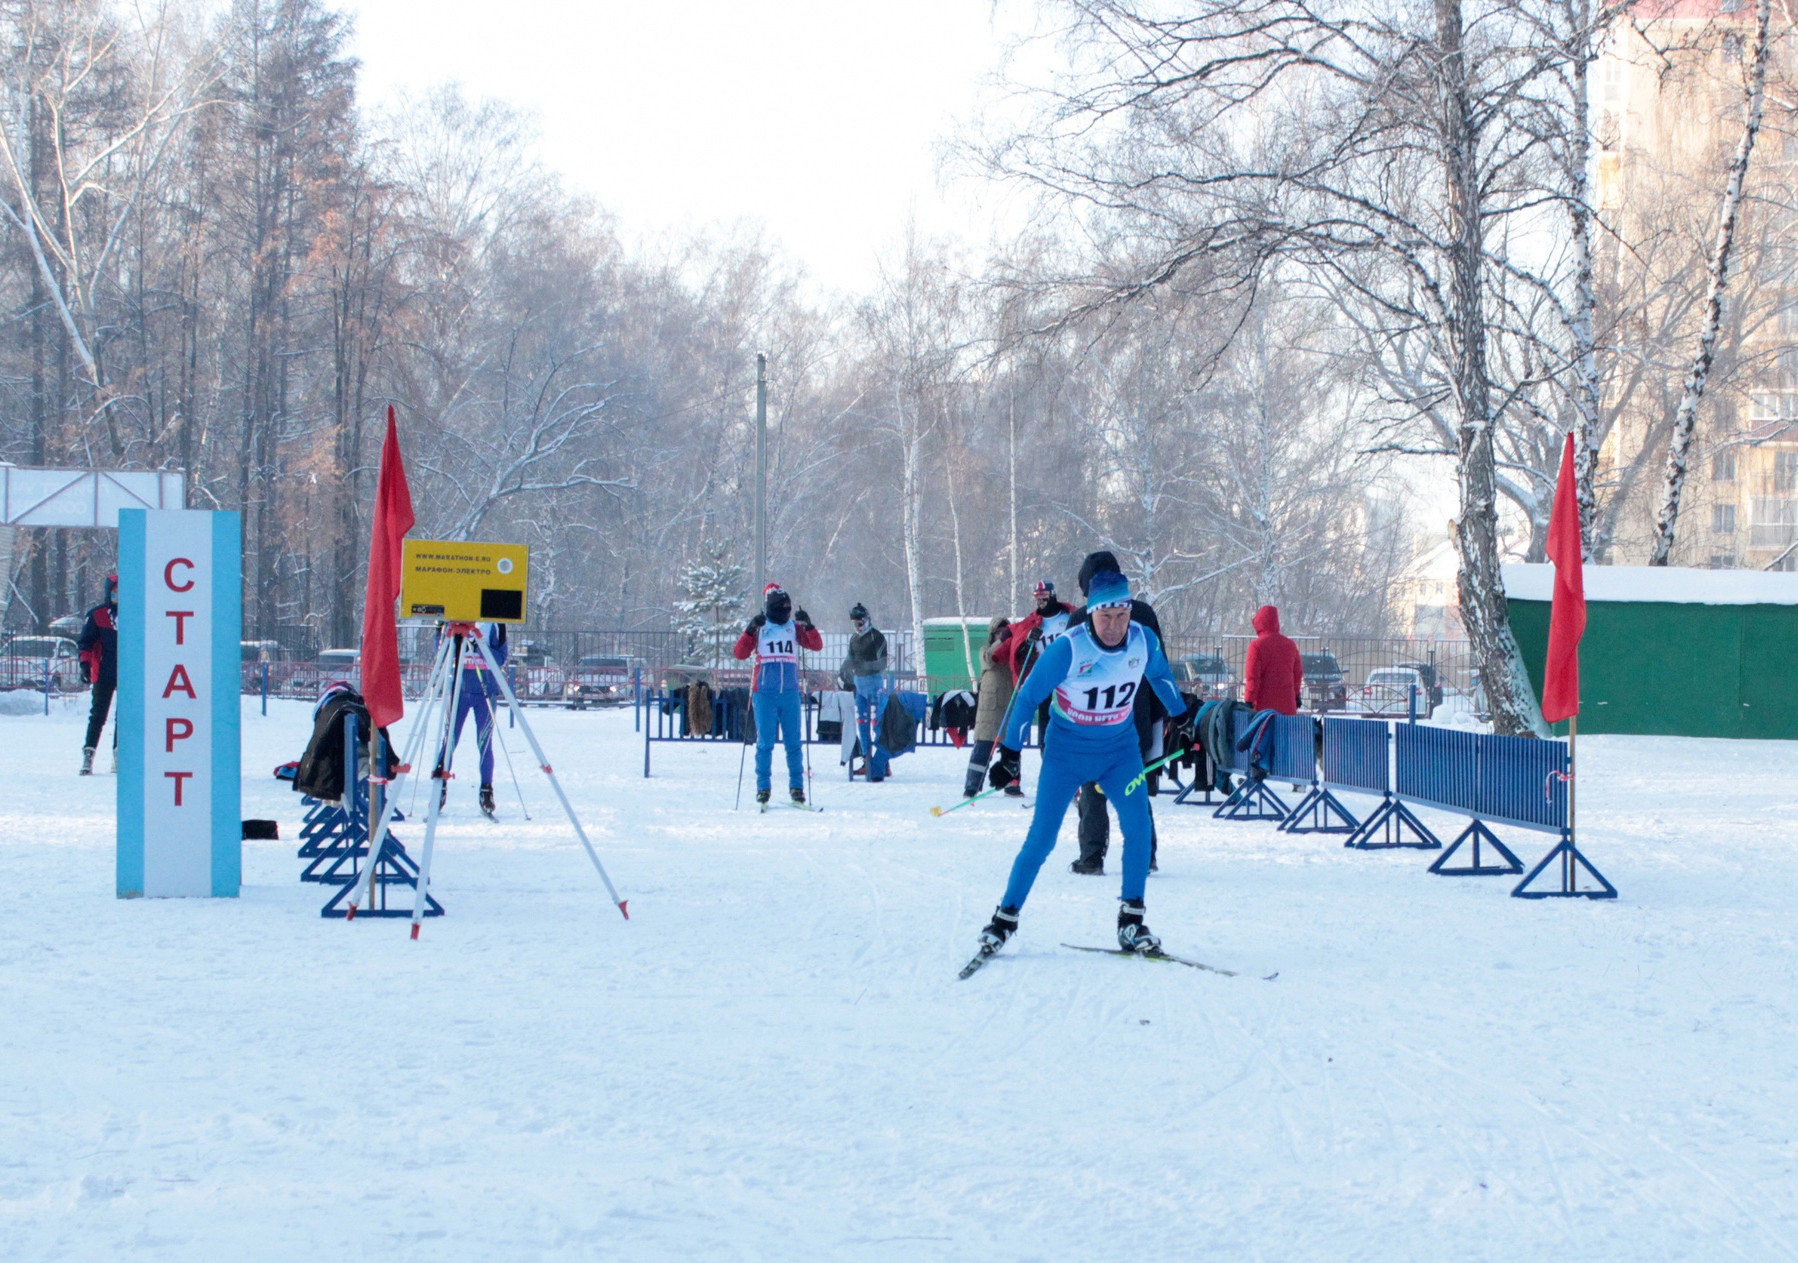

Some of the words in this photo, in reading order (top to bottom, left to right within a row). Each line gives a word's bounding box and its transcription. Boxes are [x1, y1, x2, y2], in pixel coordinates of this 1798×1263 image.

[766, 640, 794, 654] 114
[162, 557, 197, 806] СТАРТ
[1082, 682, 1136, 710] 112
